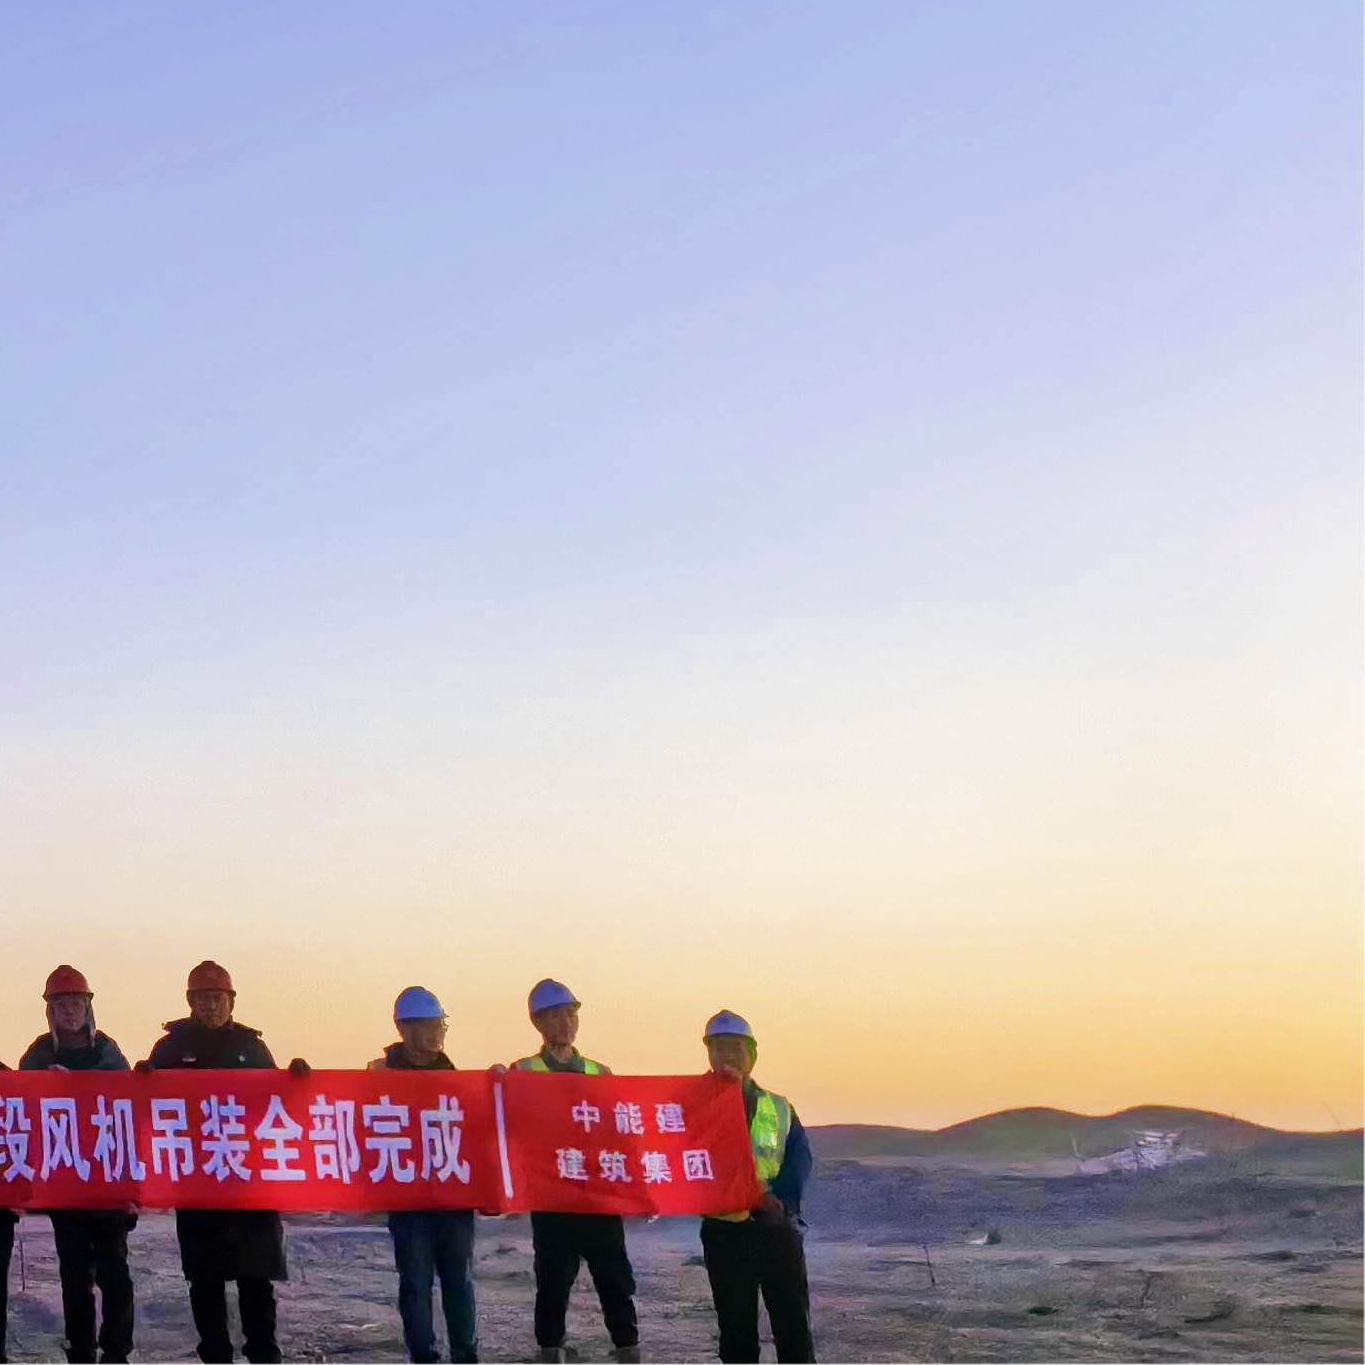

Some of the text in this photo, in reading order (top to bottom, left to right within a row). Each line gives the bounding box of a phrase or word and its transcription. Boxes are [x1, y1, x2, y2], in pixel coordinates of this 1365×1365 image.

[571, 1099, 686, 1135] 中能建
[555, 1147, 715, 1184] 建筑集团
